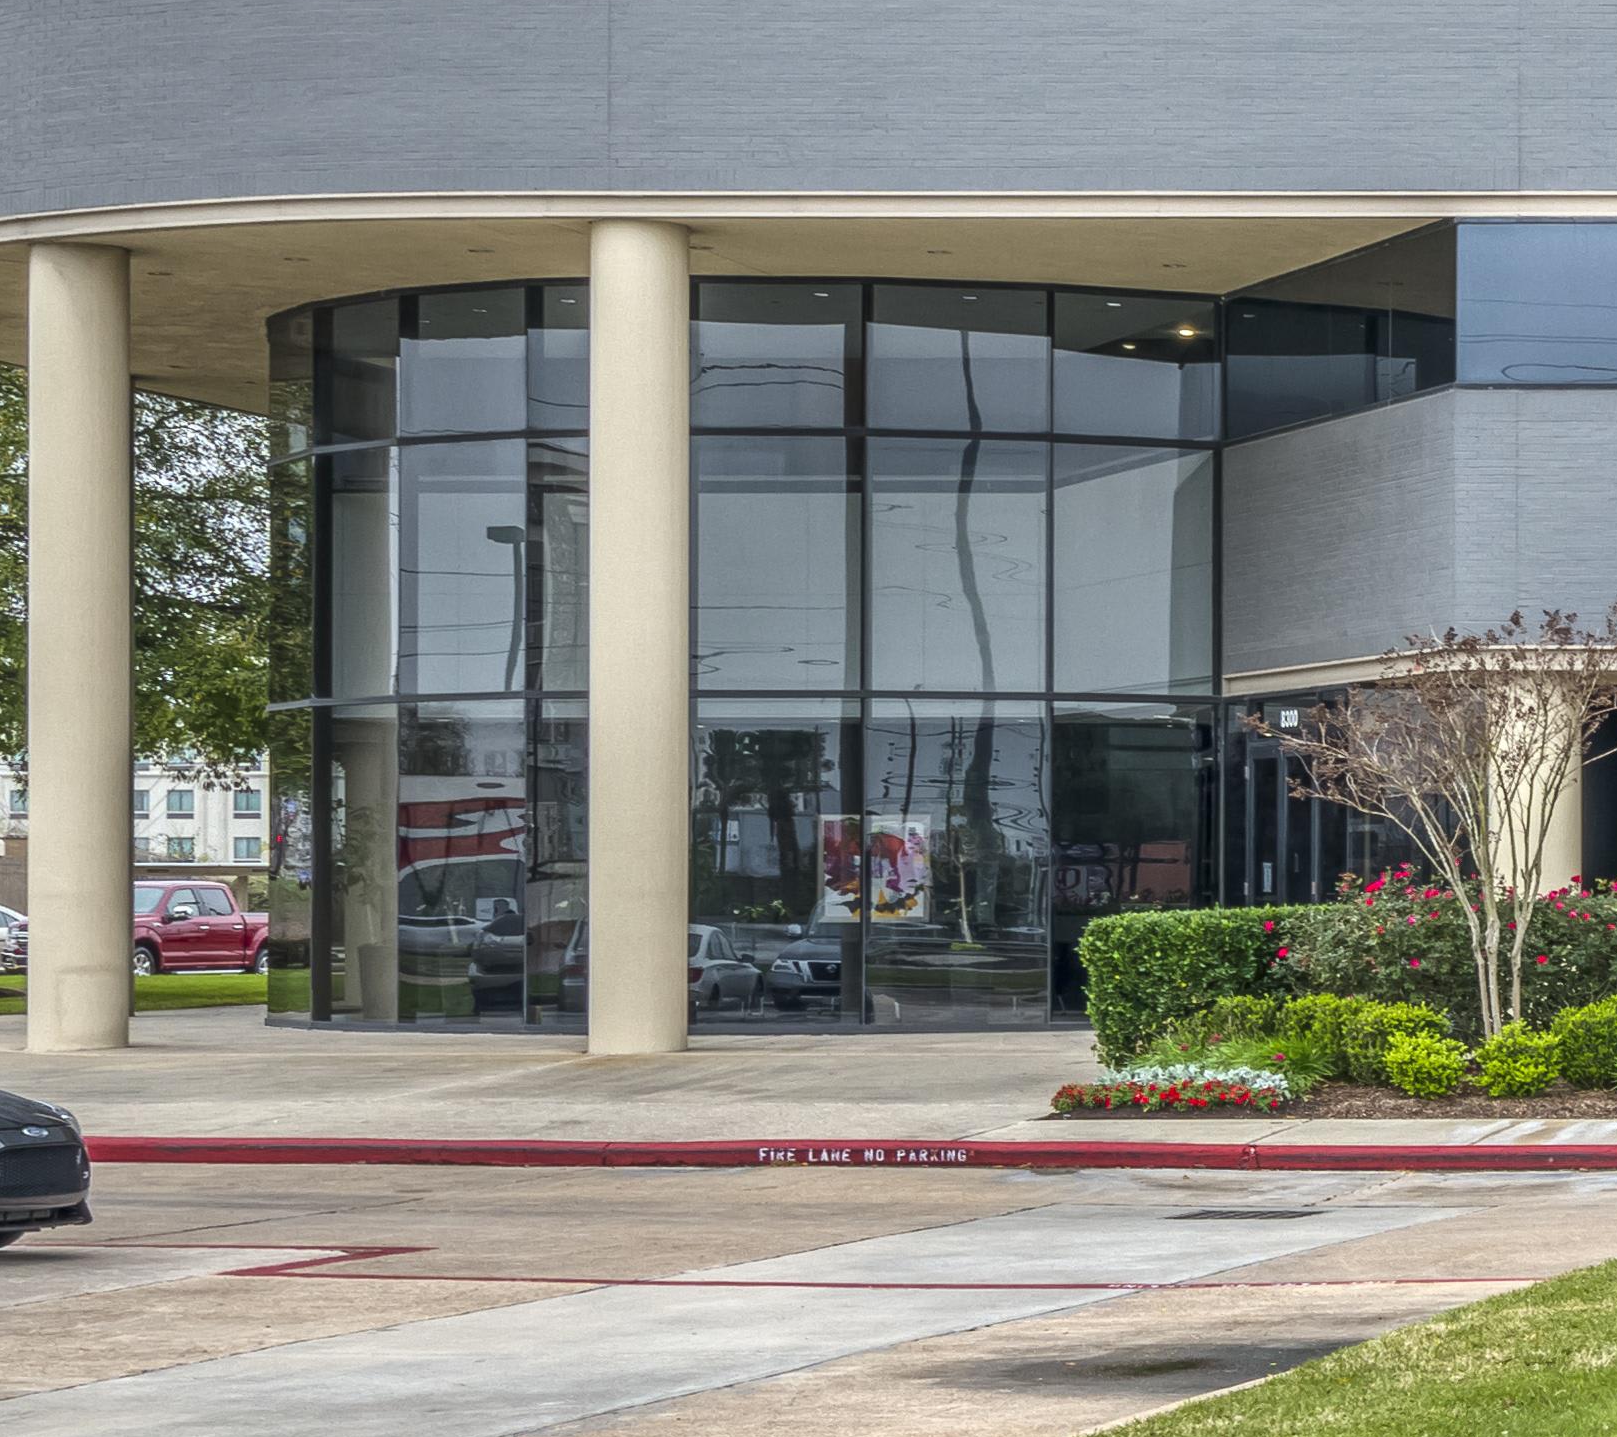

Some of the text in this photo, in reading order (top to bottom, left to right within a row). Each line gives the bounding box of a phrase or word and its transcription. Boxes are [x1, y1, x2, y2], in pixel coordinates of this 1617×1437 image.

[758, 1147, 968, 1163] FIRE LANE NO PARKING
